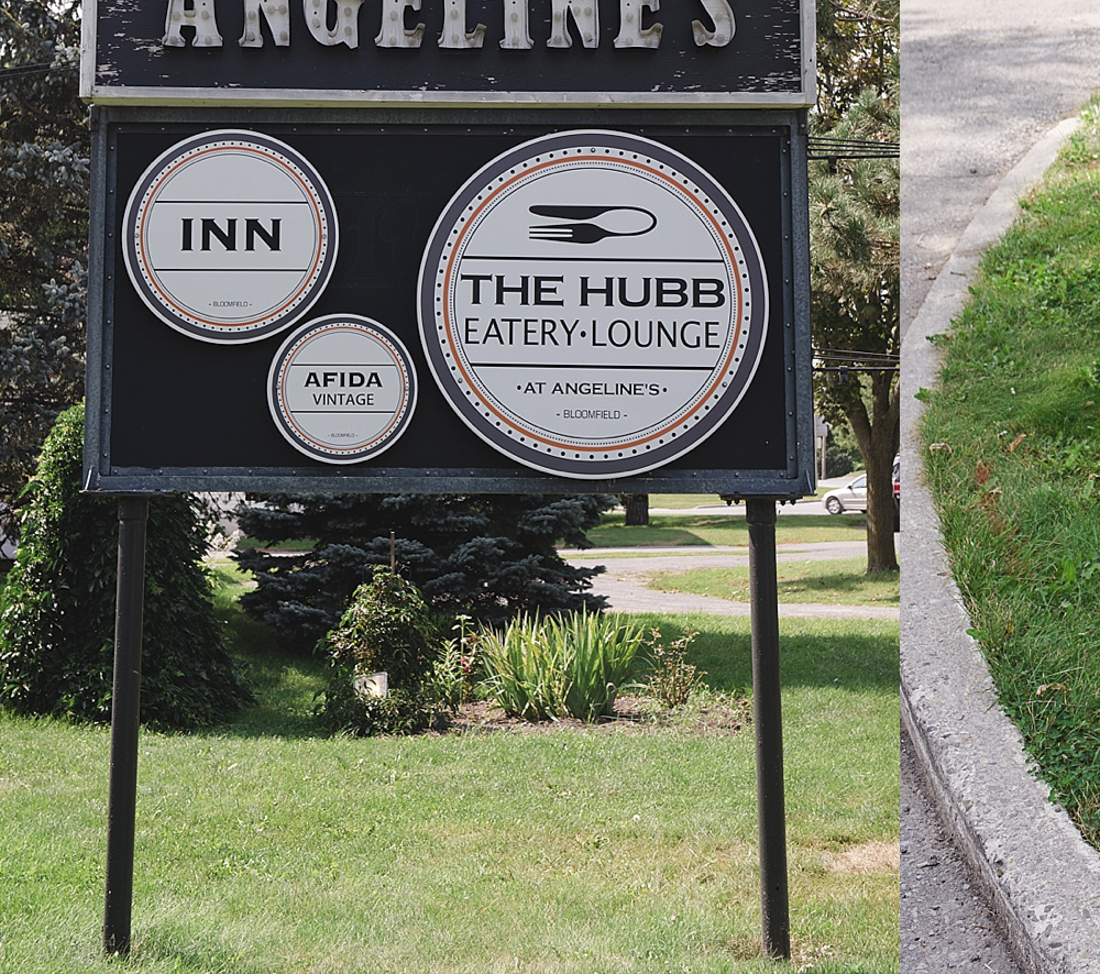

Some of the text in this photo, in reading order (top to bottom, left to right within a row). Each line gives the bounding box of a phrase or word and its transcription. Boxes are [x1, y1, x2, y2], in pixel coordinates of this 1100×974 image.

[180, 218, 283, 252] INN
[461, 273, 726, 308] THE HUBB
[304, 371, 384, 388] AFIDA
[523, 382, 661, 397] AT ANGELINE'S
[313, 392, 375, 406] VINTAGE
[562, 409, 621, 421] BLOOMFIELD
